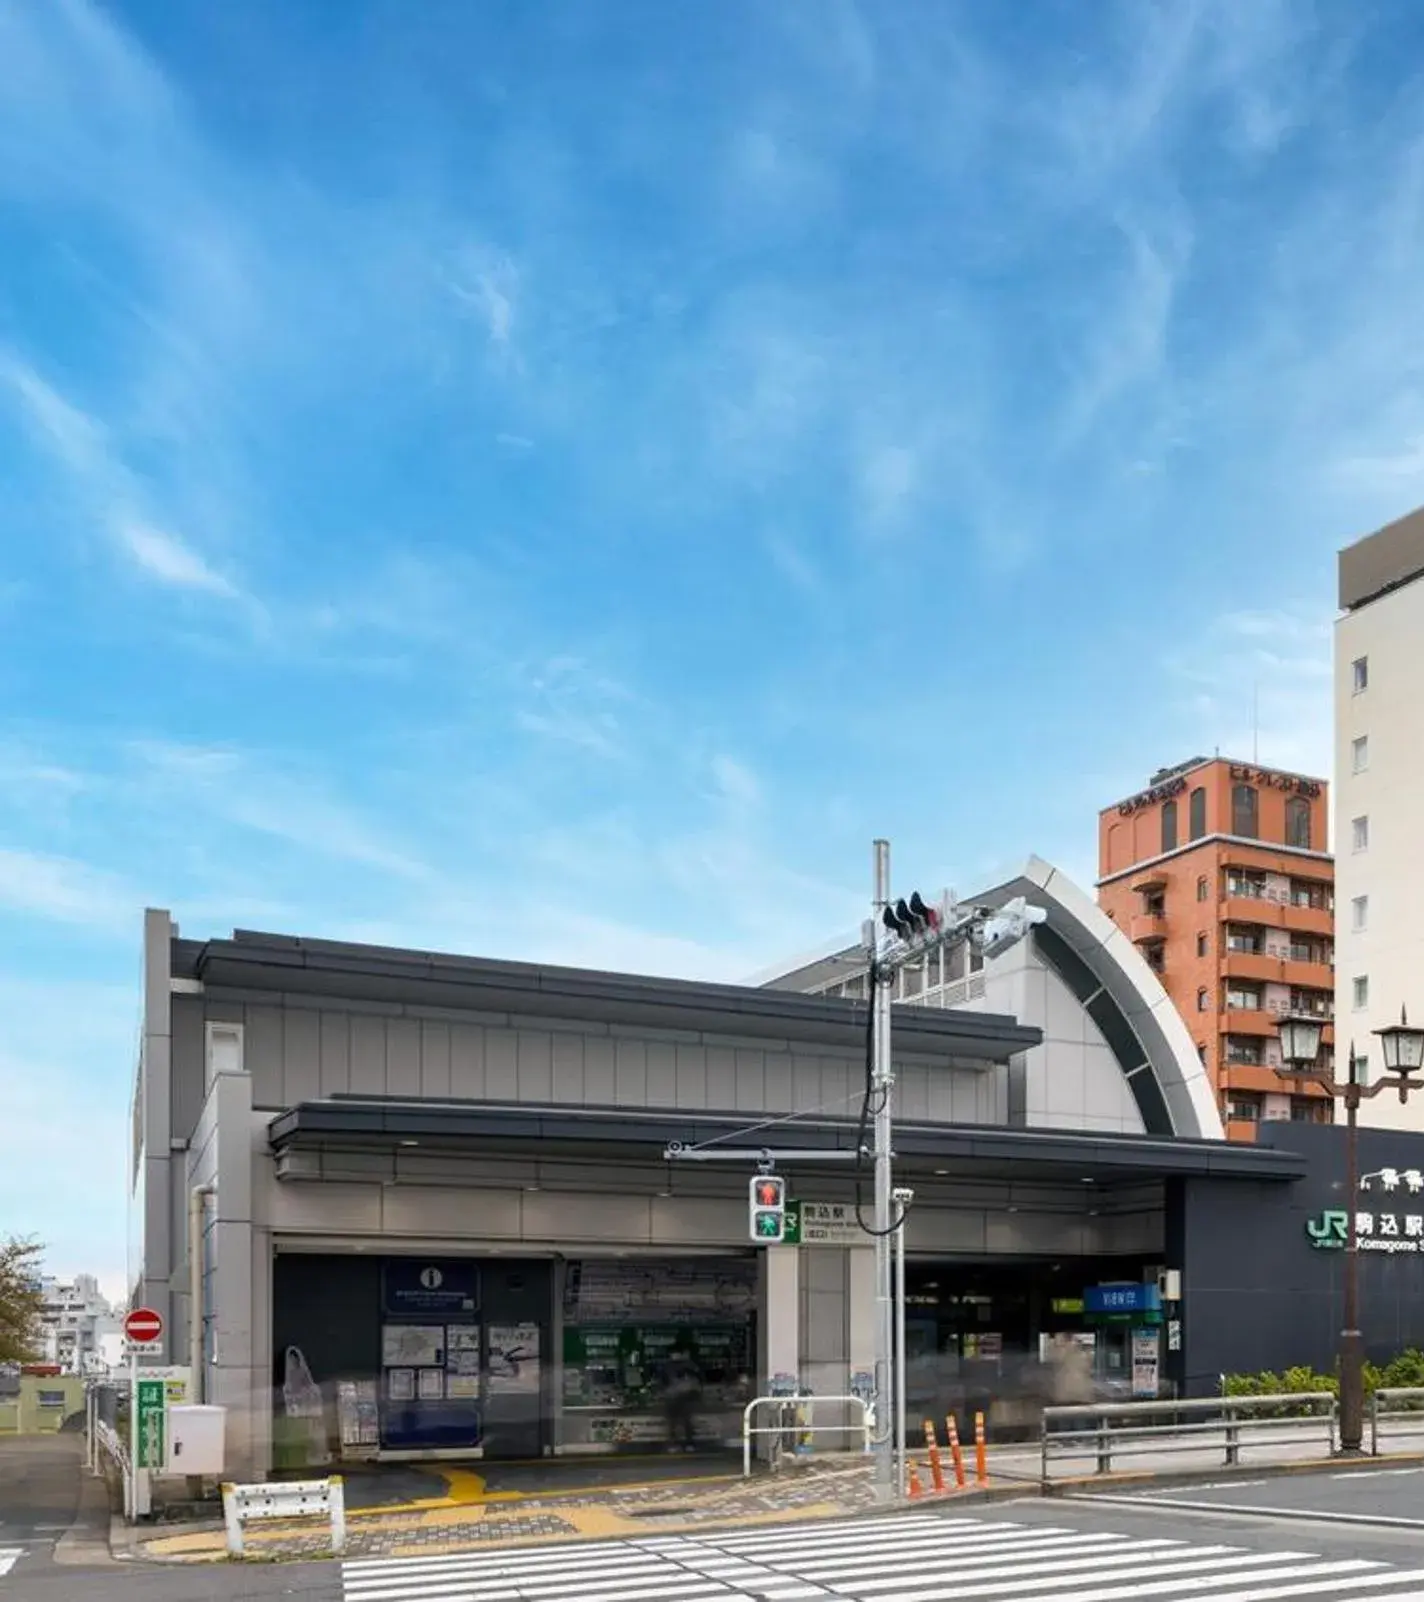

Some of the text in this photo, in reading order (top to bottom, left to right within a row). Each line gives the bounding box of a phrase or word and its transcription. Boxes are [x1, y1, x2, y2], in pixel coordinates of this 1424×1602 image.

[1307, 1210, 1349, 1239] JR
[1355, 1212, 1423, 1236] 駒込駅
[1356, 1237, 1418, 1253] Komagome
